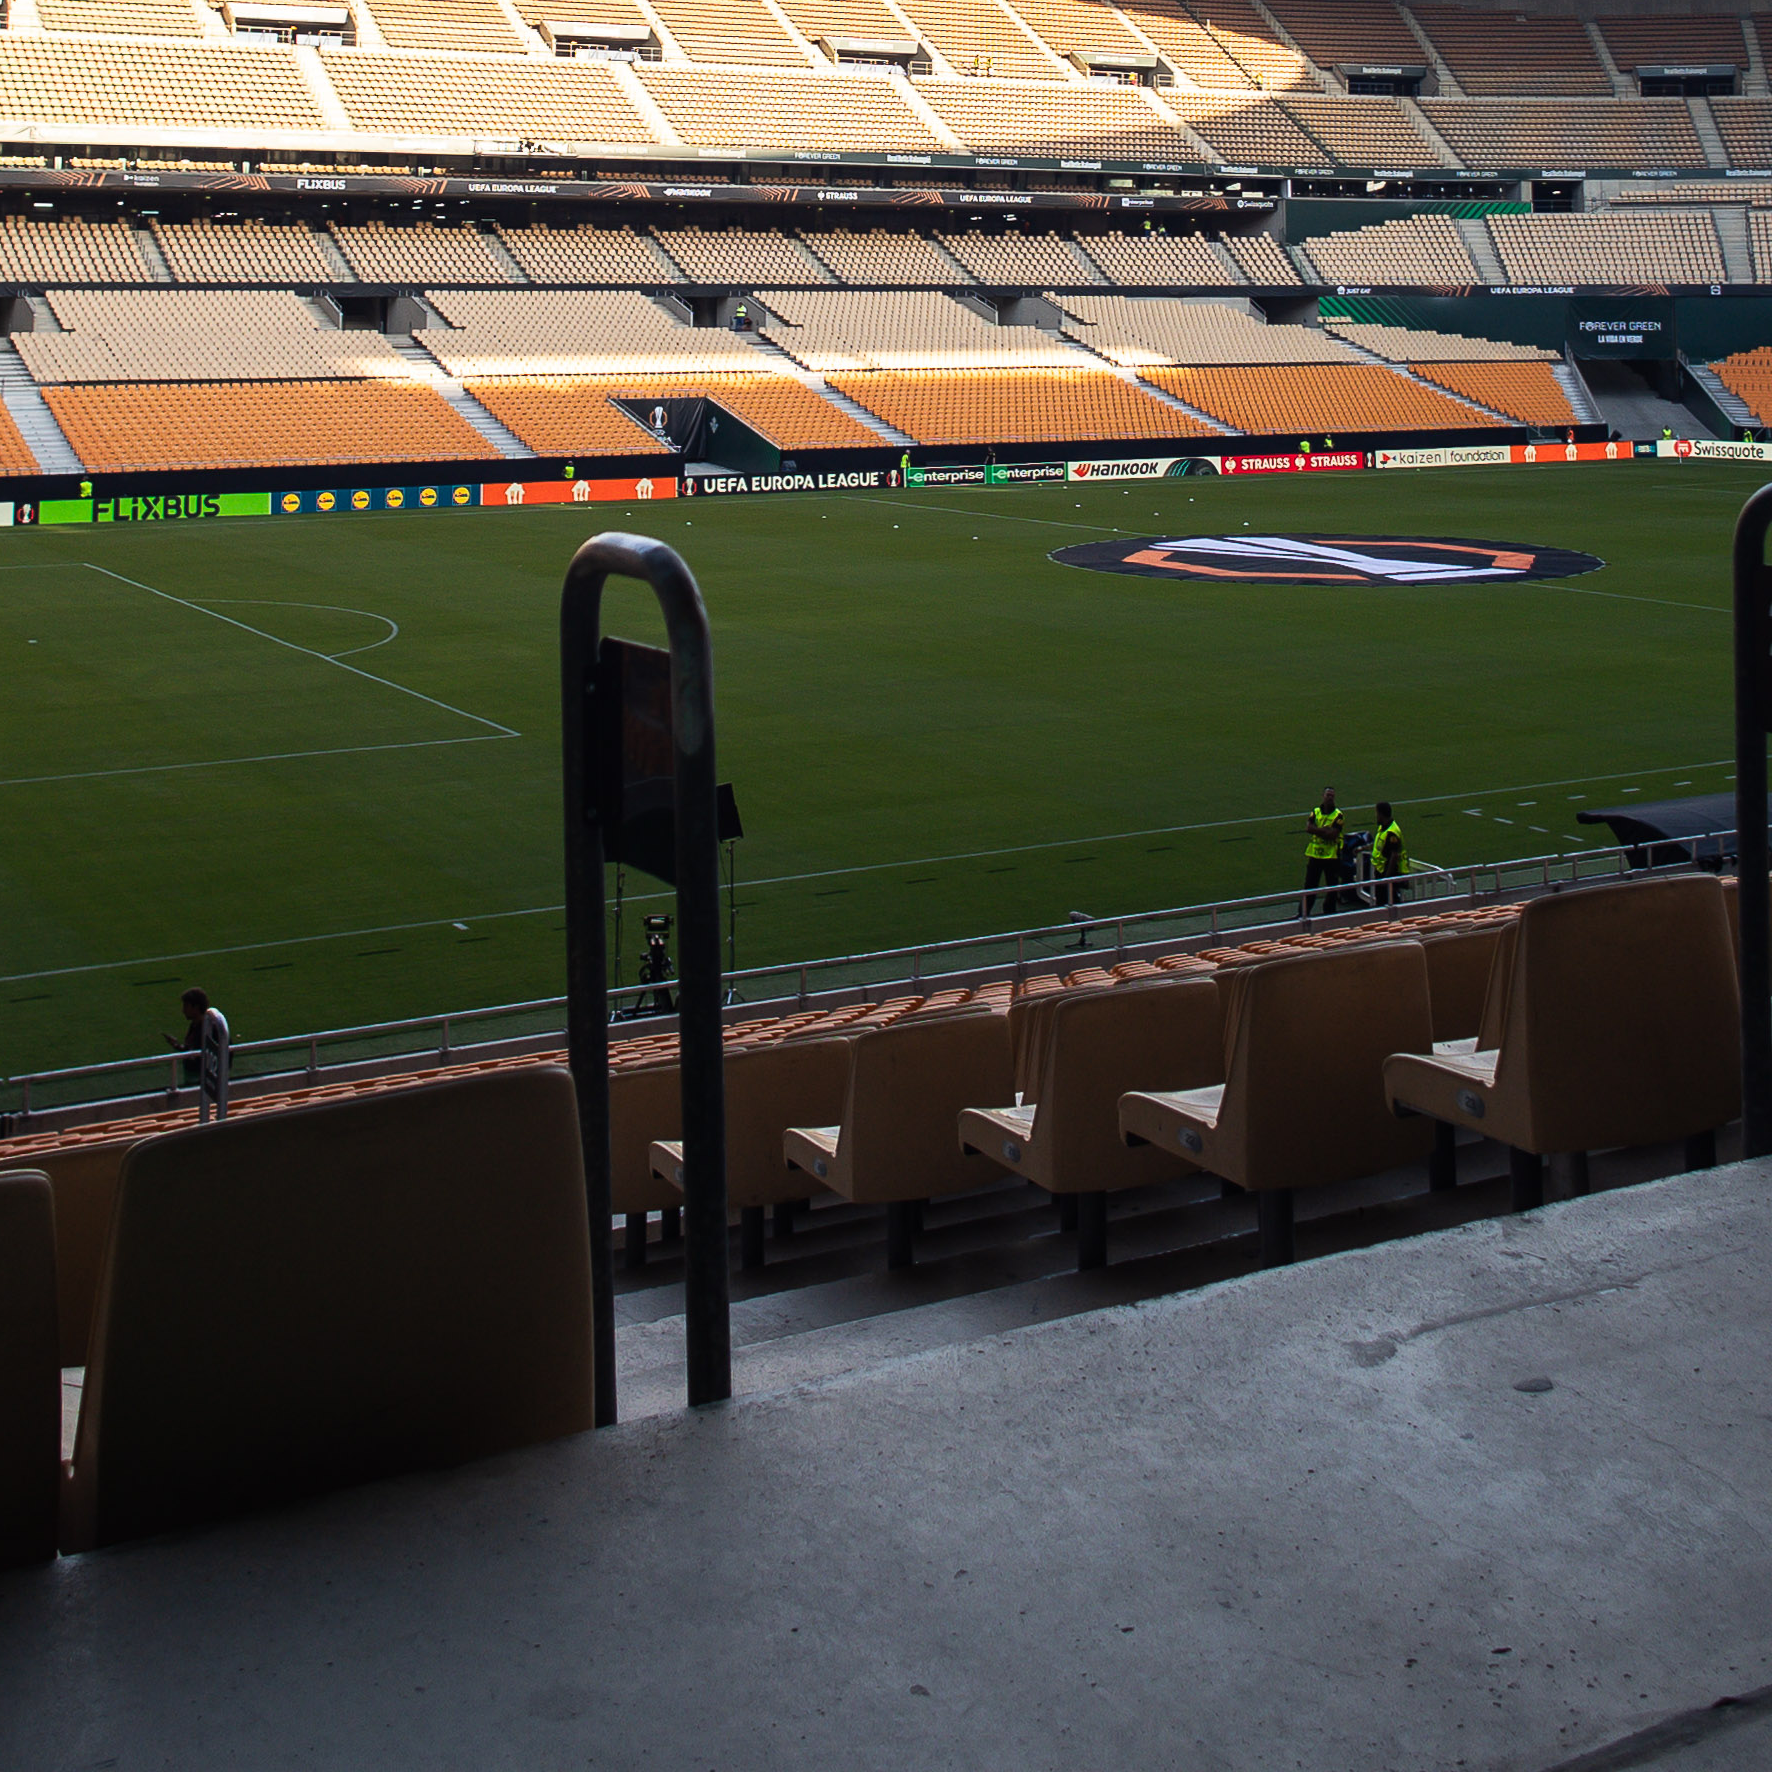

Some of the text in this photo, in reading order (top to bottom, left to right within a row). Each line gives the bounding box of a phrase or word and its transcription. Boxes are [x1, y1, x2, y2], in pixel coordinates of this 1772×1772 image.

[469, 184, 556, 193] UEFA EUROPA LEAGUE
[1512, 287, 1543, 295] EUROPA
[1543, 287, 1575, 295] LEAGUE
[1579, 321, 1662, 332] FOREVER GREEN
[1399, 448, 1505, 464] kaizen foundation
[1694, 440, 1764, 460] Swissquote
[1241, 454, 1358, 470] STRAUSS STRAUSS
[909, 468, 985, 484] enterprise
[993, 465, 1064, 481] enterprise
[704, 471, 879, 494] UEFA EUROPA LEAGUE
